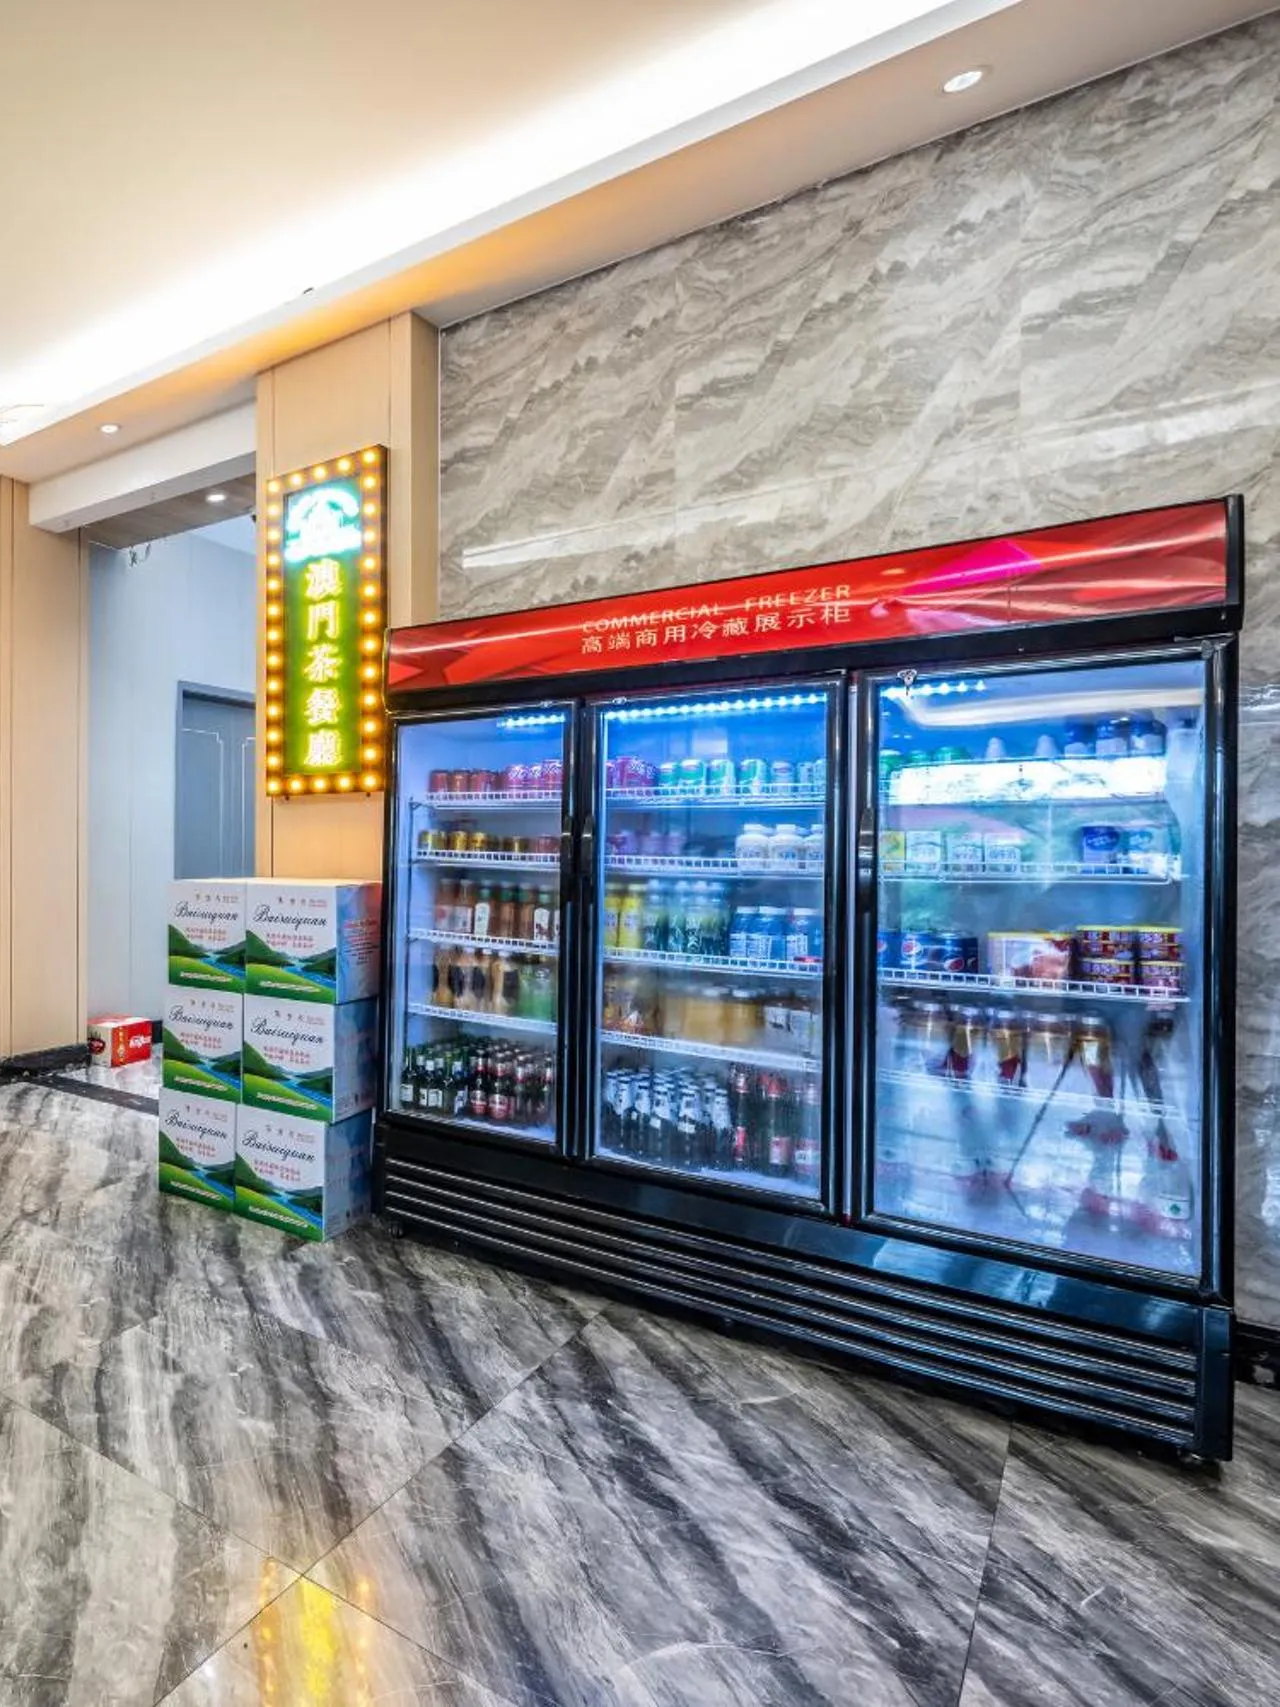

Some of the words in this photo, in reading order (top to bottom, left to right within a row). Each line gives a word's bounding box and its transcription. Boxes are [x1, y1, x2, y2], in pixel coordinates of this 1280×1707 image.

[581, 603, 852, 654] 高端商用冷藏展示柜
[582, 602, 724, 633] COMMERCIAL
[744, 584, 851, 610] FREEZER
